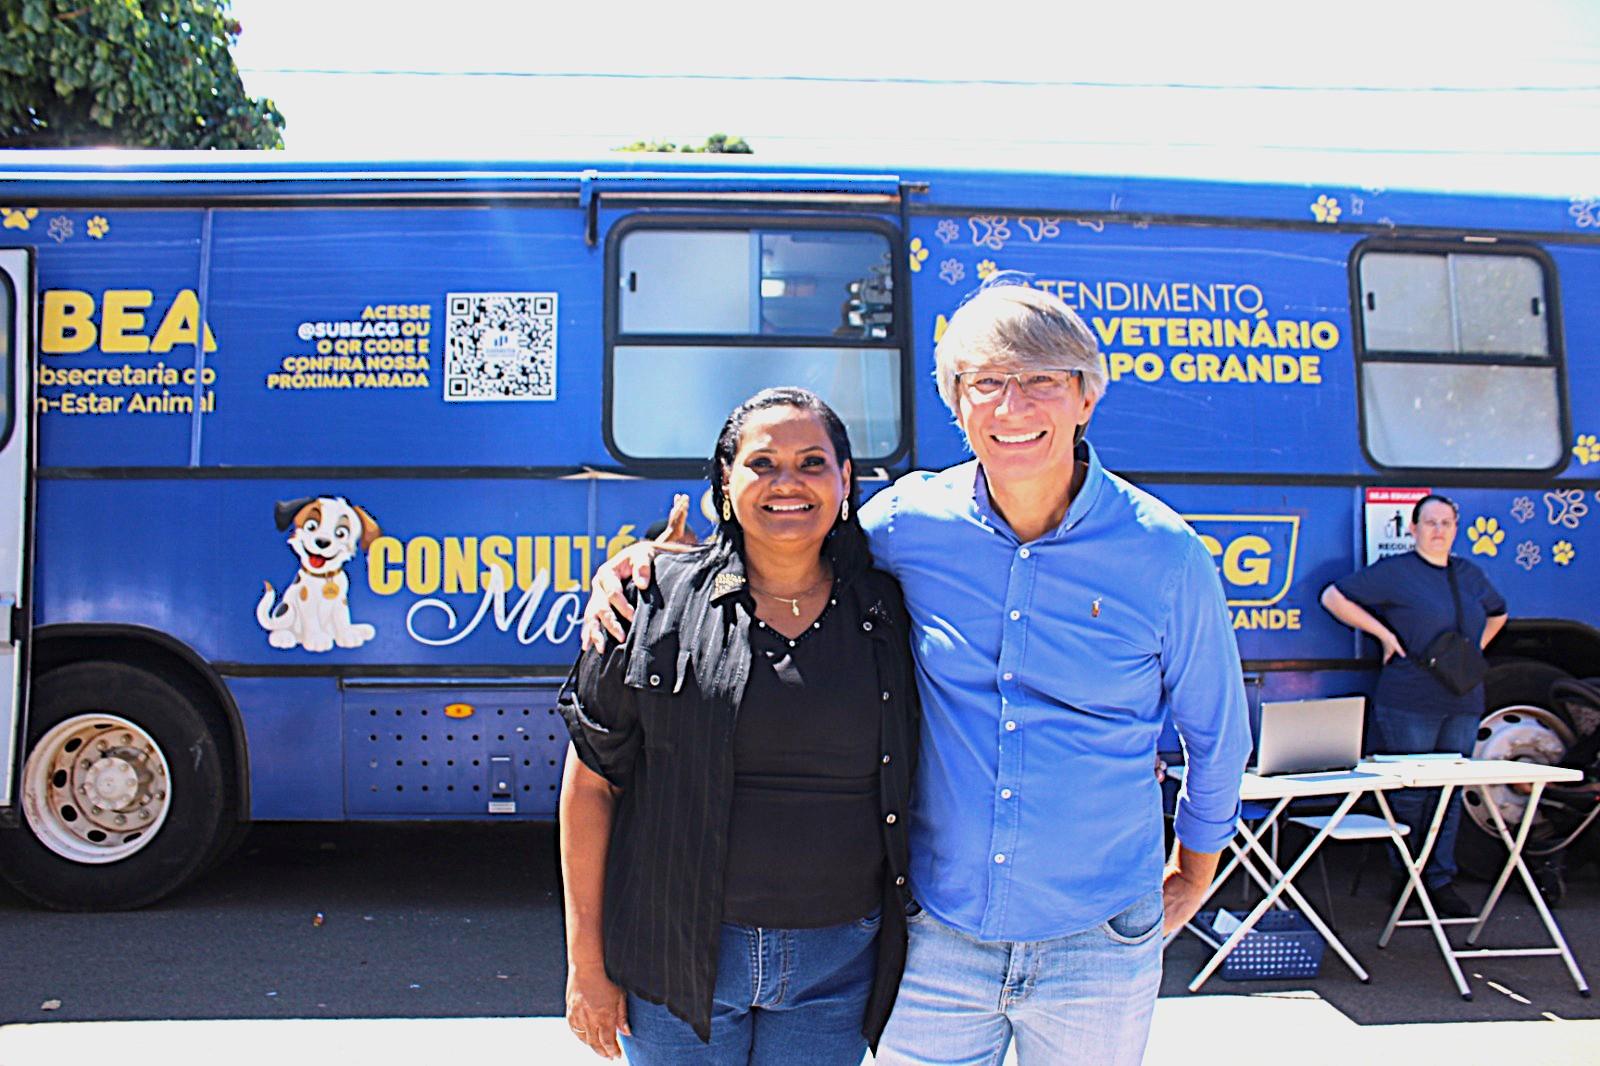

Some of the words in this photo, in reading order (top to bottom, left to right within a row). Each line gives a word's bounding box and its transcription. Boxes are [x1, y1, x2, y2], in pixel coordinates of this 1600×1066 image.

[361, 305, 431, 320] ACESSE
[297, 321, 400, 341] @SUBEACG
[401, 321, 431, 337] OU
[1092, 308, 1340, 351] VETERINÁRIO
[316, 339, 333, 354] O
[334, 339, 362, 356] QR
[364, 339, 415, 354] CODE
[417, 339, 430, 354] E
[283, 356, 364, 371] CONFIRA
[366, 355, 430, 371] NOSSA
[1170, 353, 1322, 384] GRANDE
[37, 362, 178, 386] bsecretaria
[267, 369, 350, 390] PRÓXIMA
[353, 372, 430, 388] PARADA
[1227, 608, 1302, 631] ANDE
